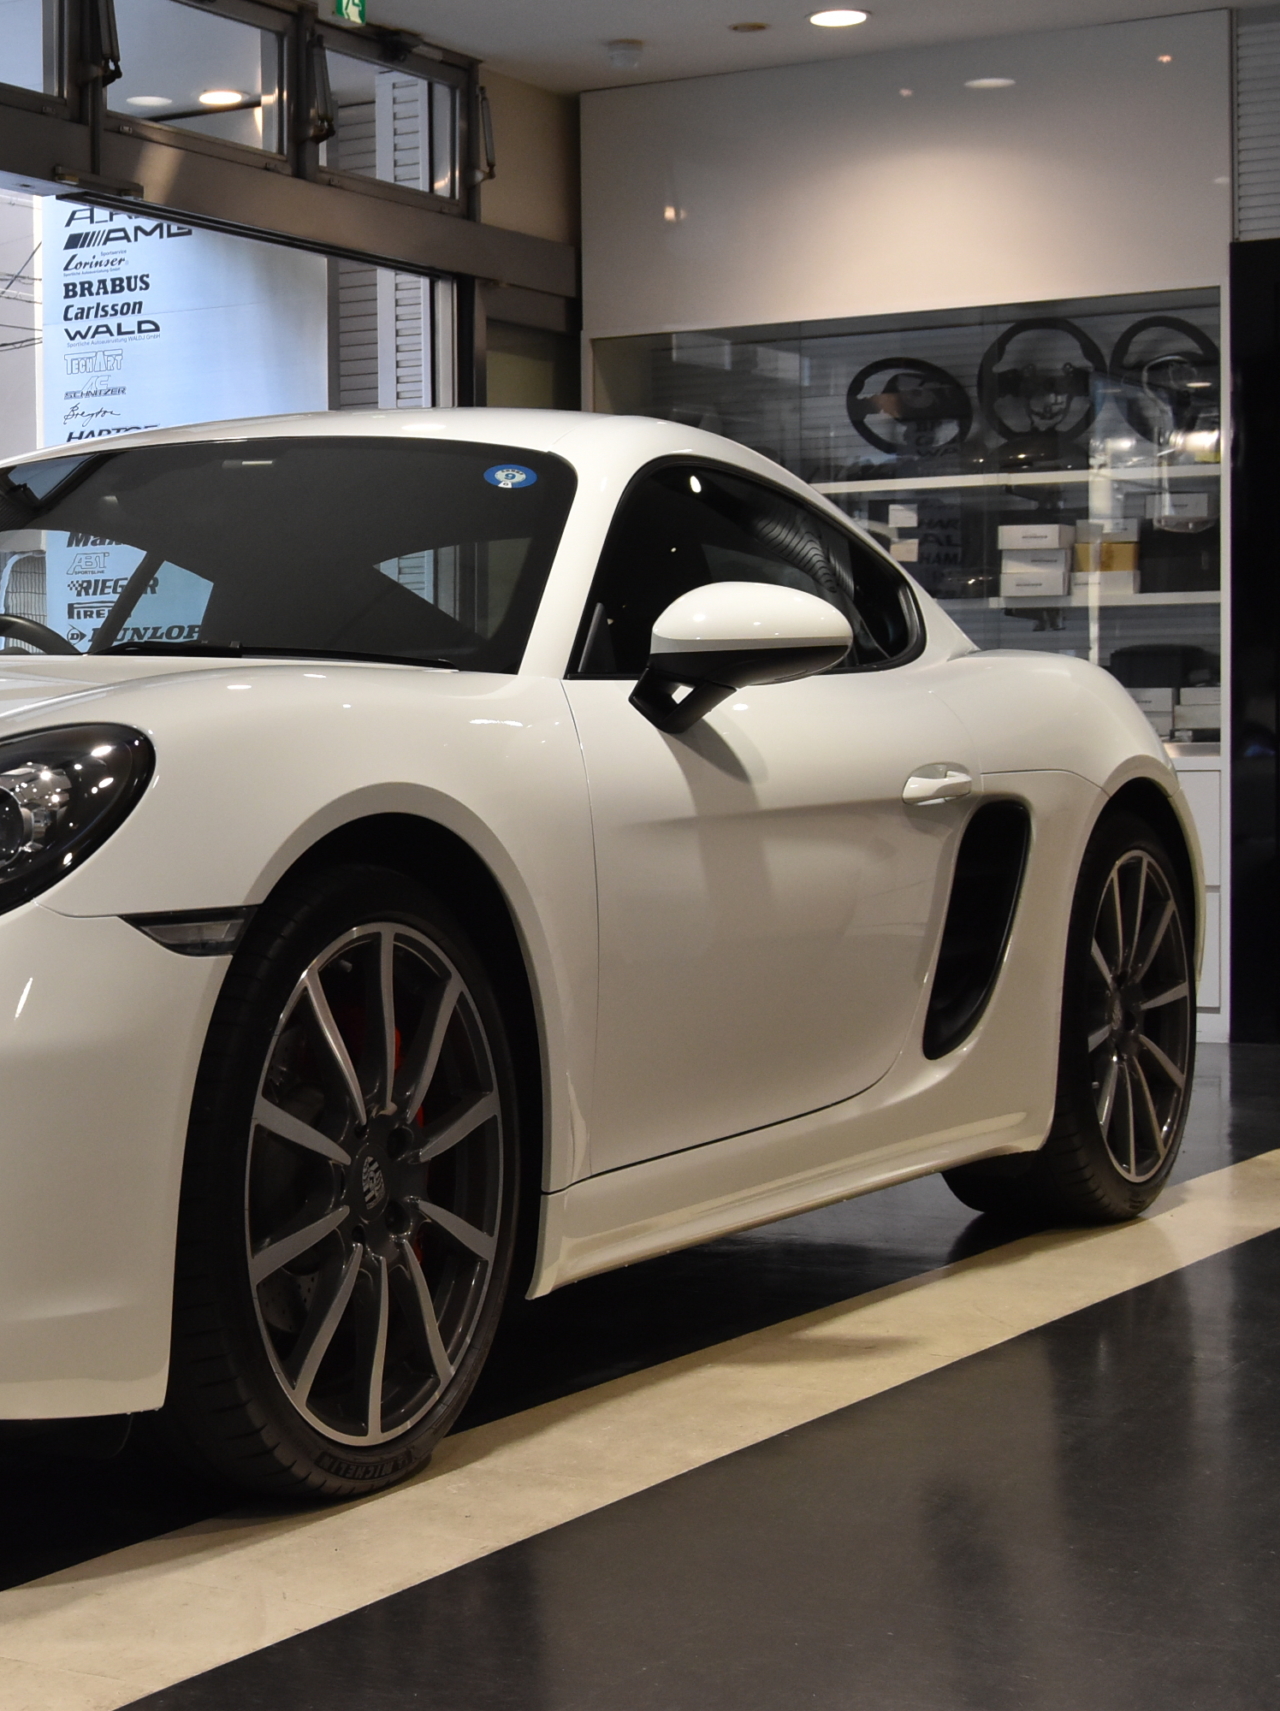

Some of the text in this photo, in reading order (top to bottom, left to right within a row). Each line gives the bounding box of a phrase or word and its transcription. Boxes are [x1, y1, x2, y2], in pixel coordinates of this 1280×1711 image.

[63, 254, 126, 272] Lorinser
[63, 274, 150, 300] BRABUS
[63, 300, 143, 322] Carlsson
[64, 320, 160, 341] WALD
[64, 386, 127, 400] SCHNITZER
[76, 576, 160, 598] RIEGR
[320, 1456, 394, 1479] MICHELIN
